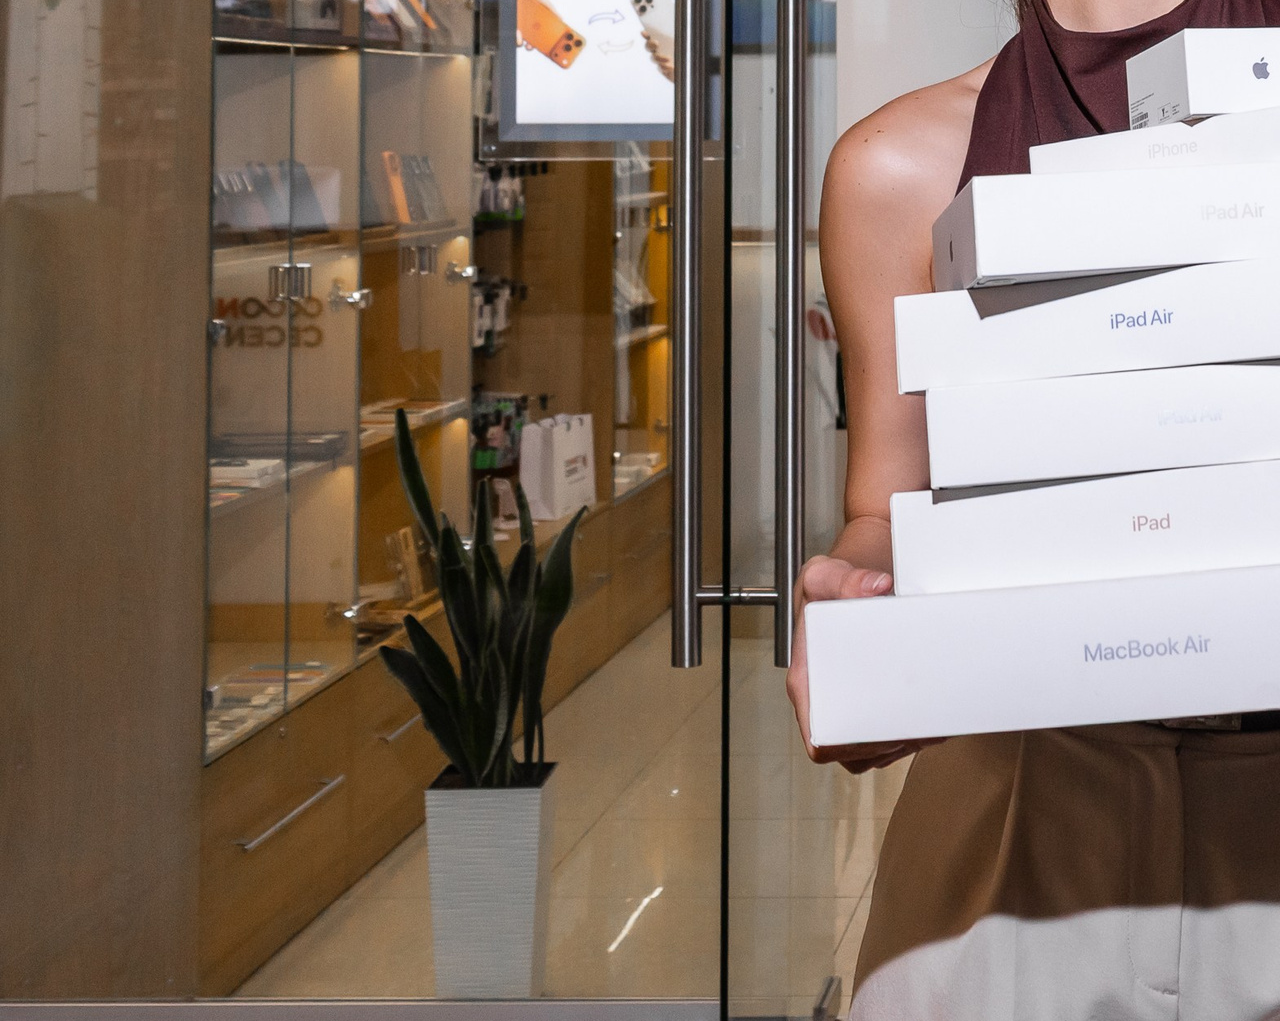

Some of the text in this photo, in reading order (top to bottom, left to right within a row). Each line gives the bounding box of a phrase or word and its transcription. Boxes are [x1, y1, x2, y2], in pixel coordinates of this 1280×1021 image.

[1147, 138, 1198, 160] iPhone
[1200, 202, 1265, 222] iPad Air
[1110, 308, 1174, 330] iPad Air
[1132, 514, 1171, 532] iPad
[1083, 635, 1211, 663] MacBook Air
